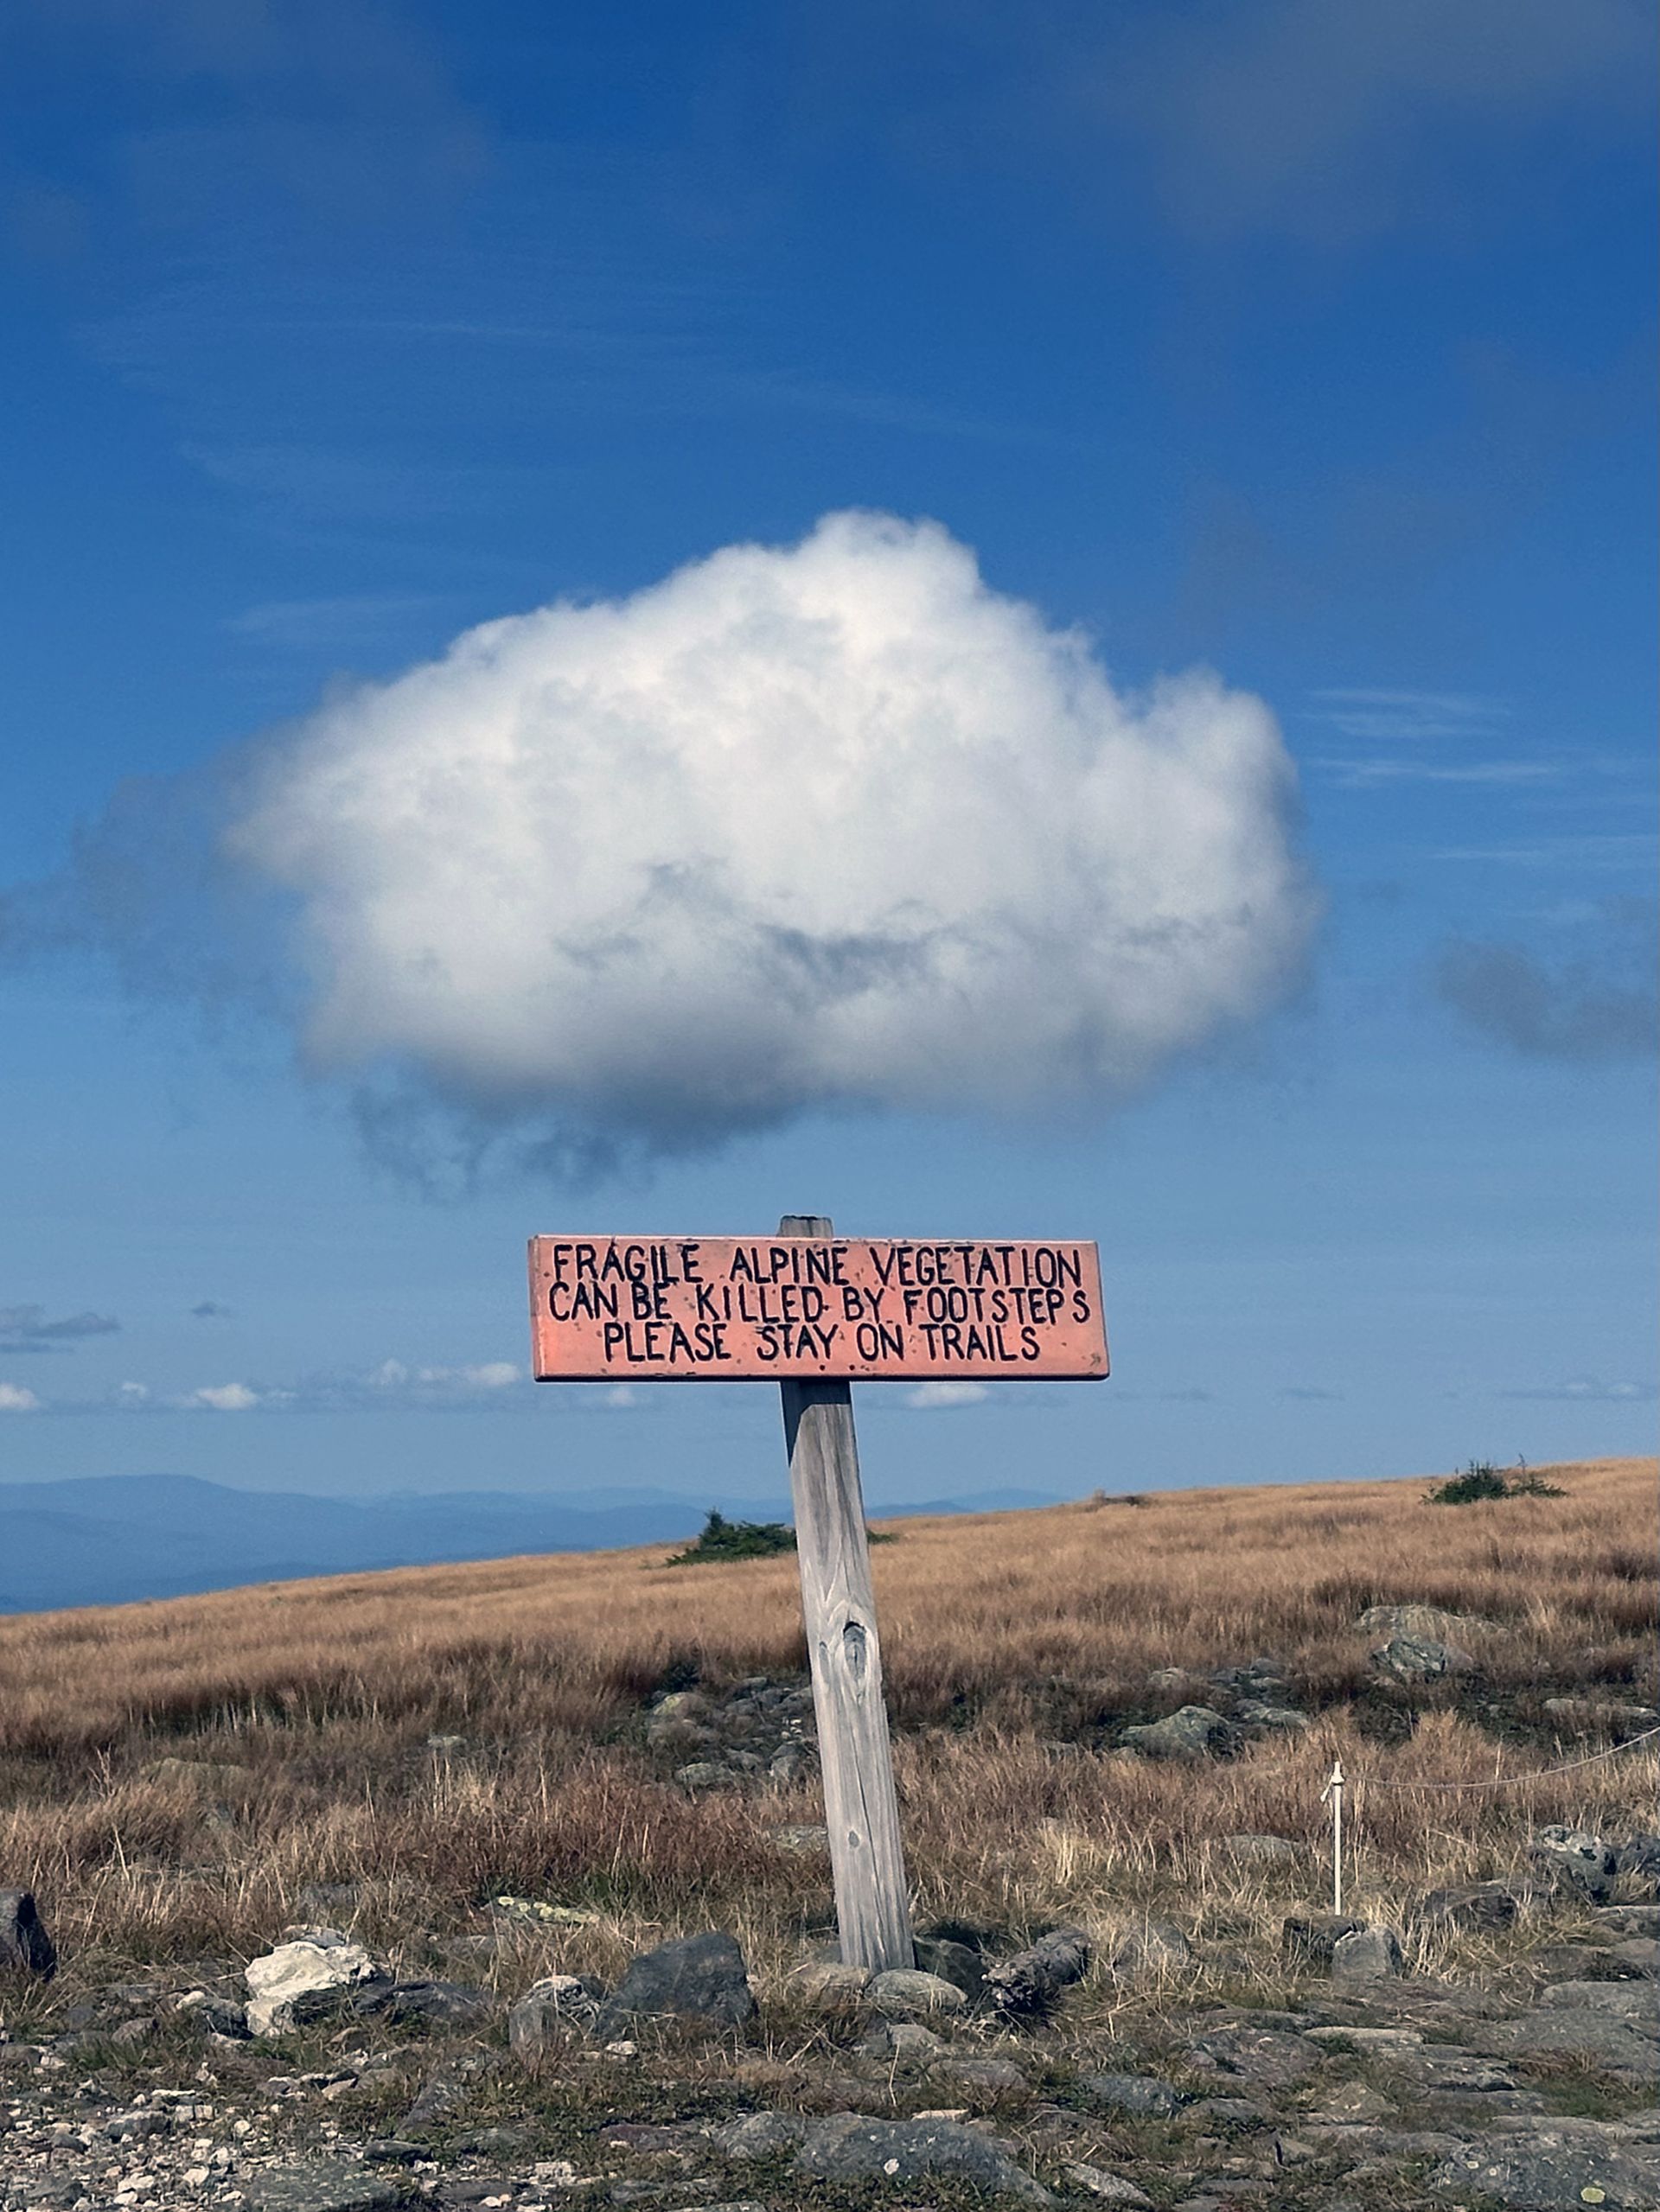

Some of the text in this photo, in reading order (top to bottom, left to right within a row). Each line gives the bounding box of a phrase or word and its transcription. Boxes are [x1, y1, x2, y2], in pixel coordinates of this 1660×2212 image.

[552, 1244, 1082, 1287] FRAGILE ALPINE VEGETATION
[549, 1282, 1090, 1325] CAN BE KILLED BY FOOTSTEPS
[603, 1322, 1041, 1361] PLEASE STAY ON TRAILS
